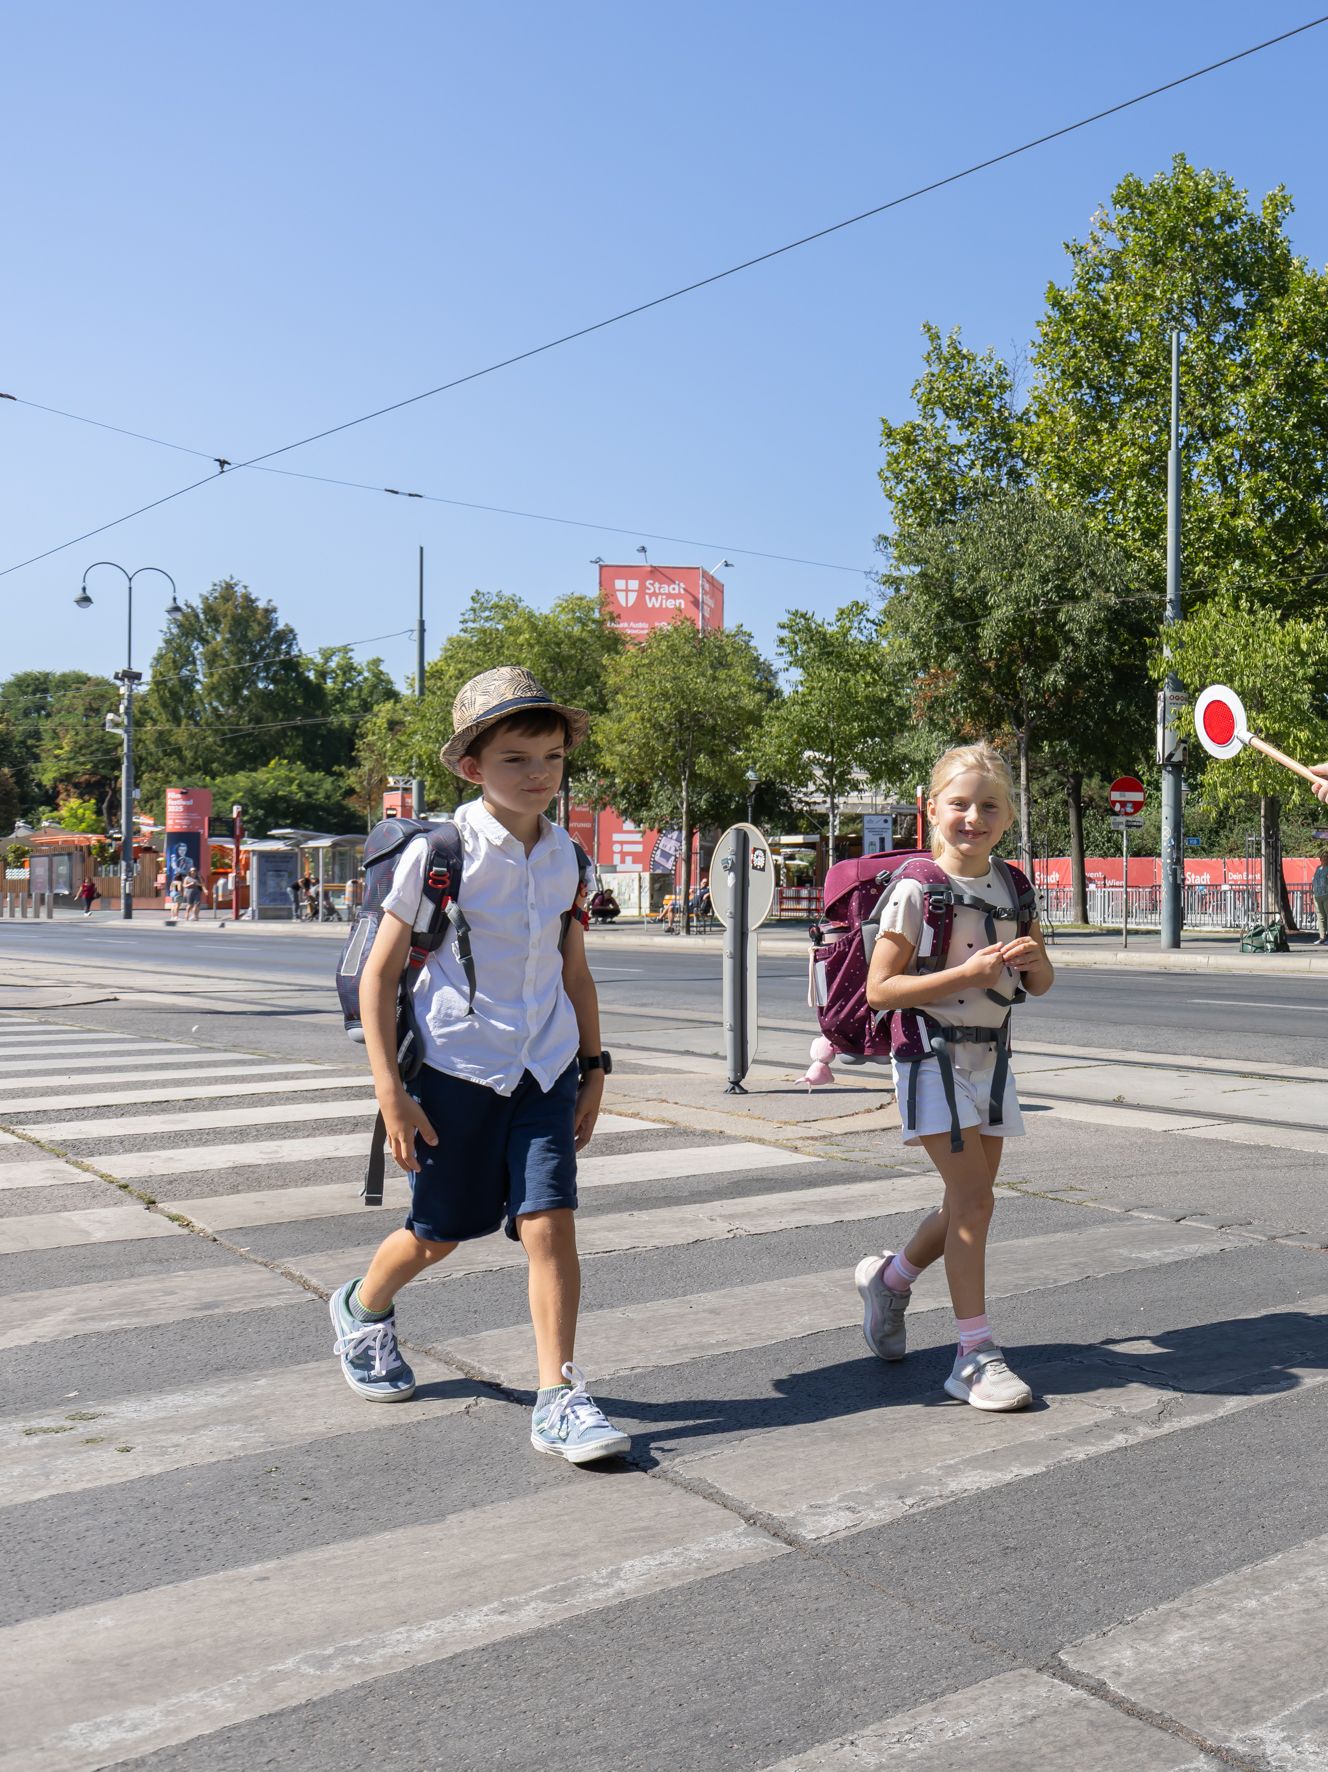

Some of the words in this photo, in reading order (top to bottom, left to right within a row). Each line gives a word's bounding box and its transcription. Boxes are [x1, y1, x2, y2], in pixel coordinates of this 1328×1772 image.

[645, 580, 686, 594] Stadt
[645, 595, 685, 608] Wien
[1035, 872, 1060, 884] Stadt
[1186, 872, 1211, 884] Stadt
[1228, 872, 1242, 880] Dein
